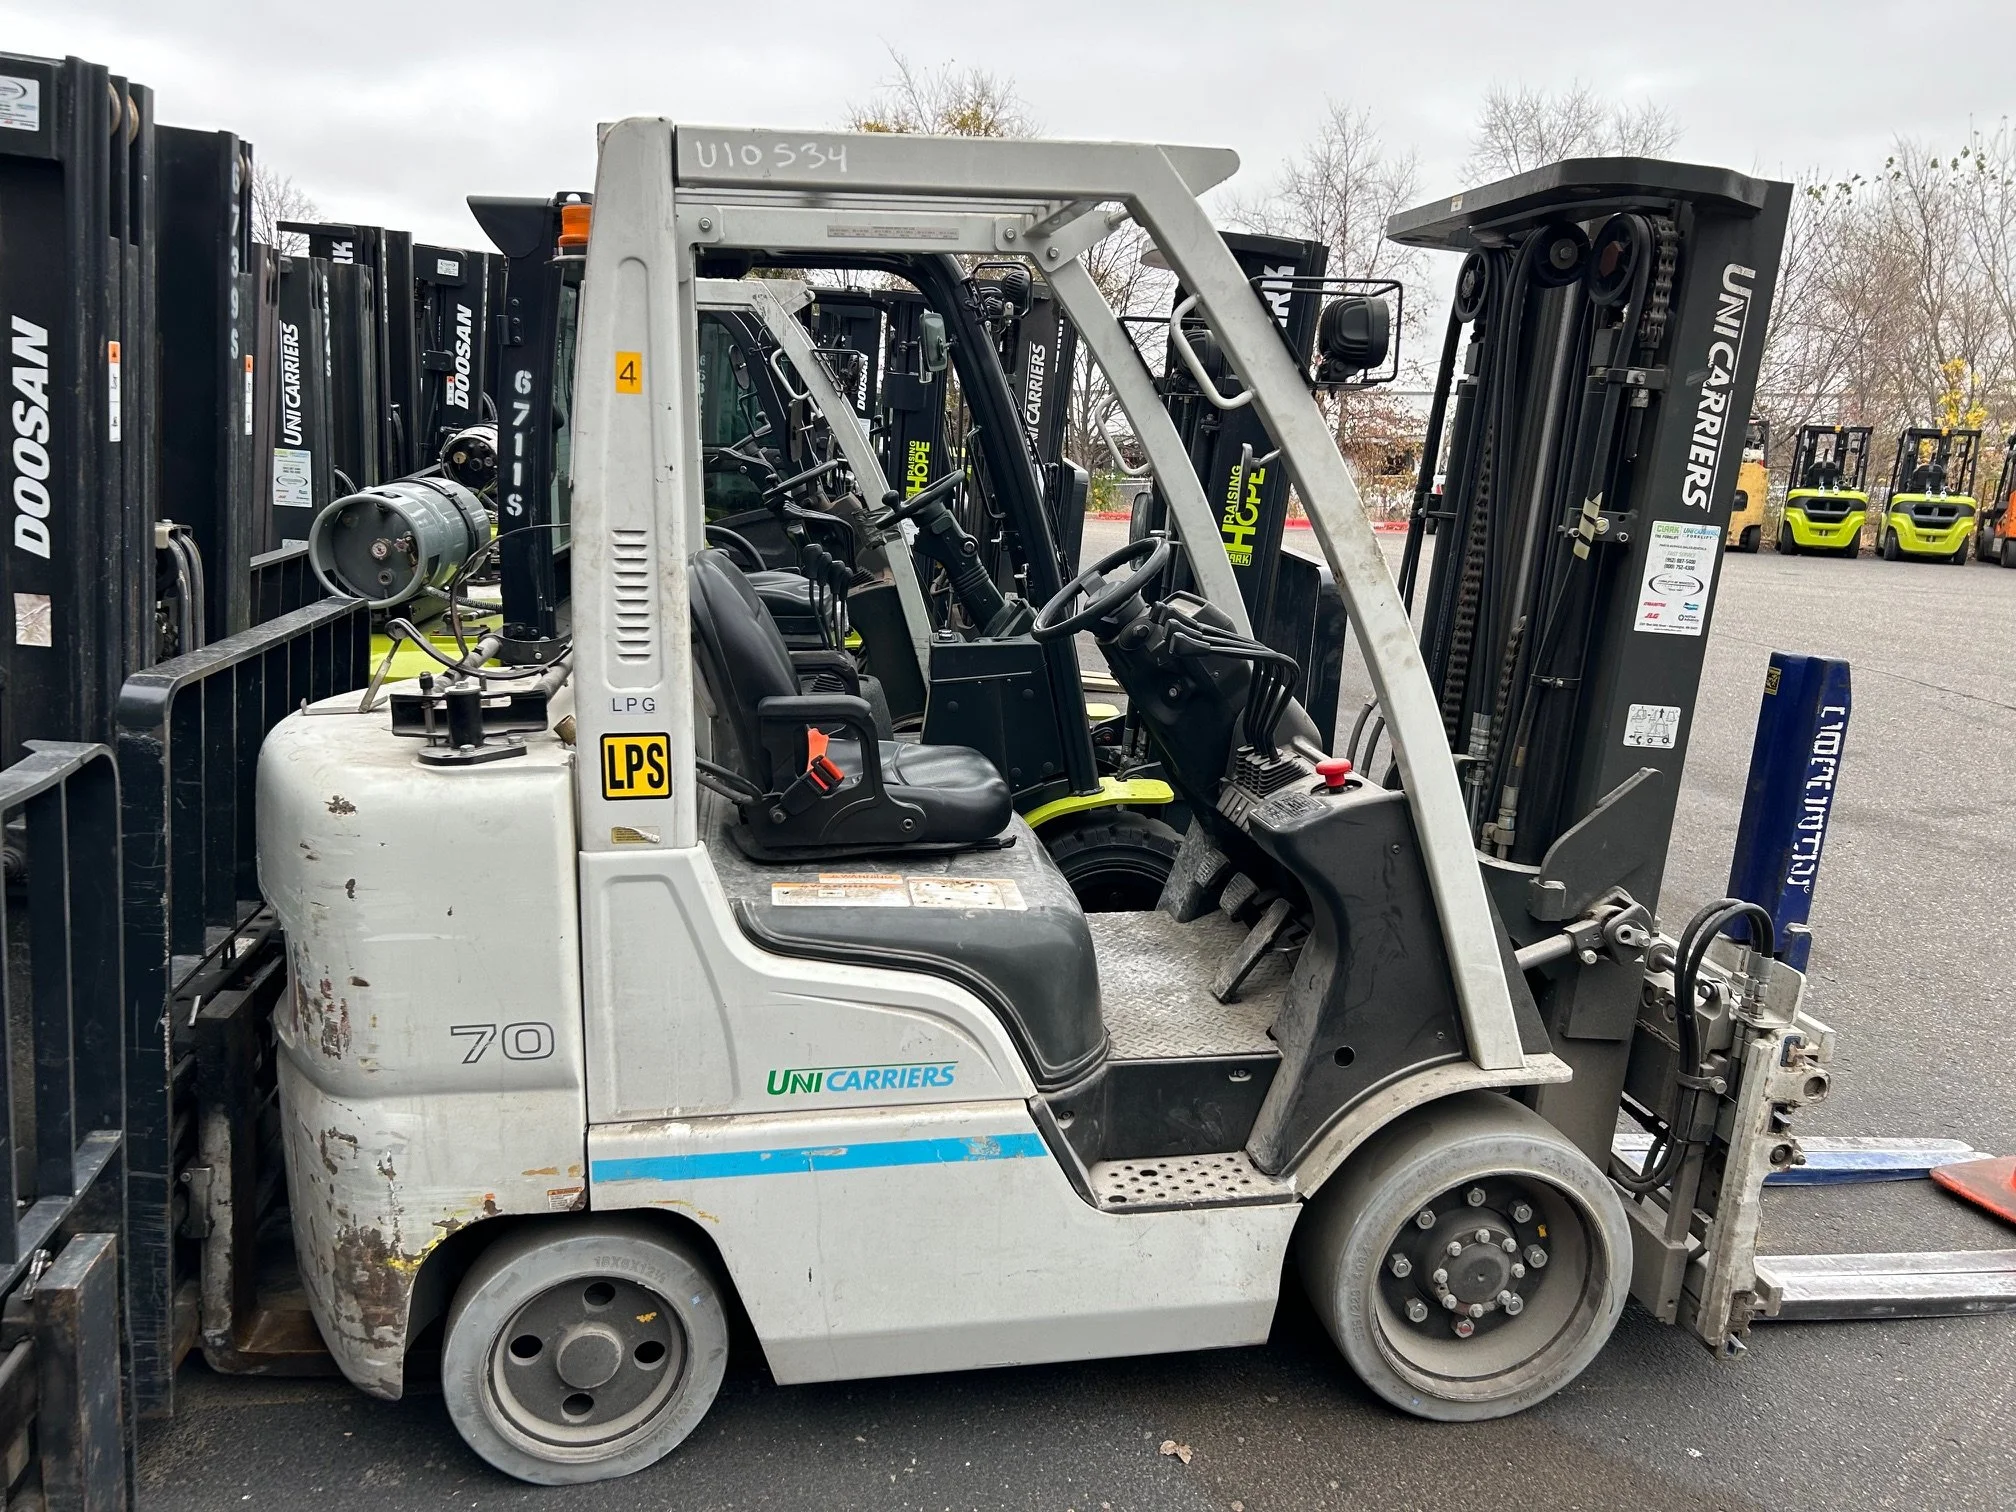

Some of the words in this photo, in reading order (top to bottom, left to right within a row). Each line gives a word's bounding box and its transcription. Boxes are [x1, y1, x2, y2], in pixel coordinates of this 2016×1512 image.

[279, 319, 303, 446] UNICARRIERS
[454, 303, 472, 410] DOOSAN
[619, 360, 637, 386] 4
[11, 314, 51, 560] DOOSAN
[506, 369, 532, 517] 6711S
[906, 440, 930, 493] HOPE
[1221, 468, 1266, 554] HOPE
[1223, 465, 1241, 524] RAISING
[612, 697, 656, 712] LPG
[608, 743, 664, 789] LPS
[450, 1022, 554, 1064] 70
